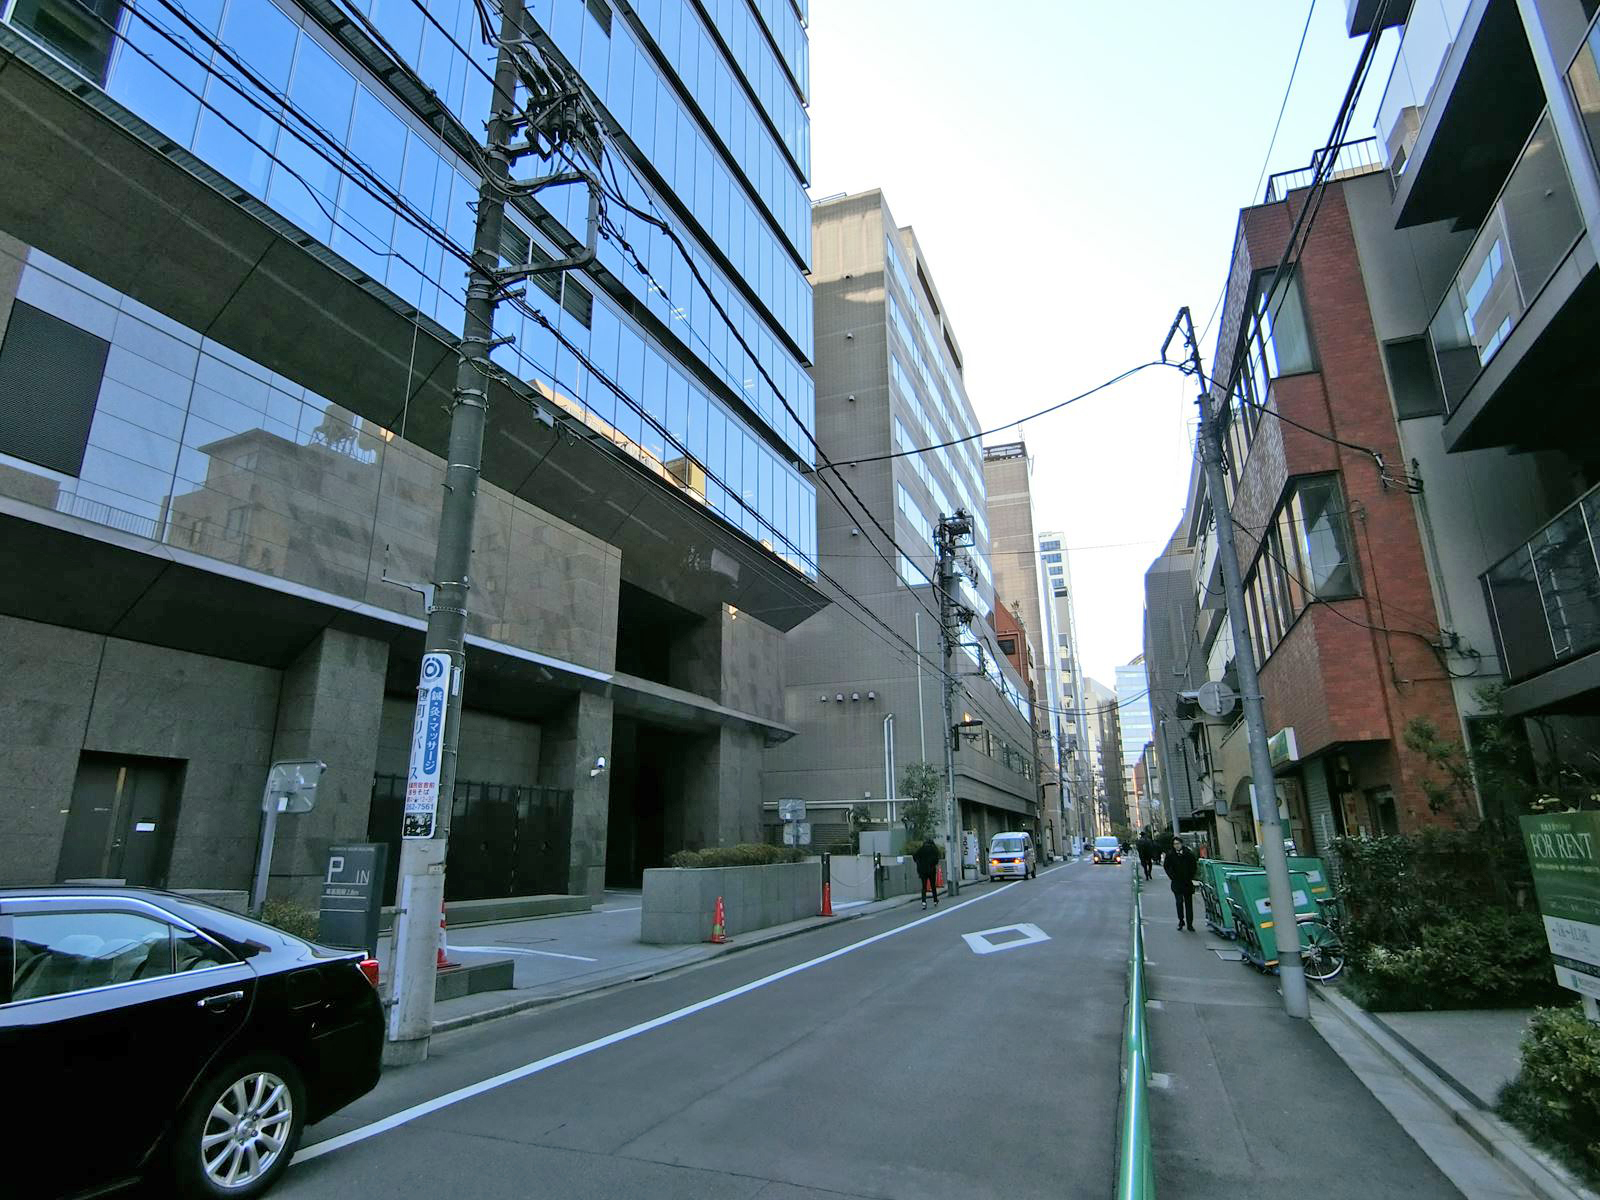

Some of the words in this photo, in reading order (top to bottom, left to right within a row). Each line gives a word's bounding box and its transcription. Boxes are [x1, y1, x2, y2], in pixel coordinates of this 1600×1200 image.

[1530, 833, 1557, 858] FOR
[1555, 832, 1593, 860] RENT
[327, 856, 345, 884] P
[355, 869, 371, 885] IN
